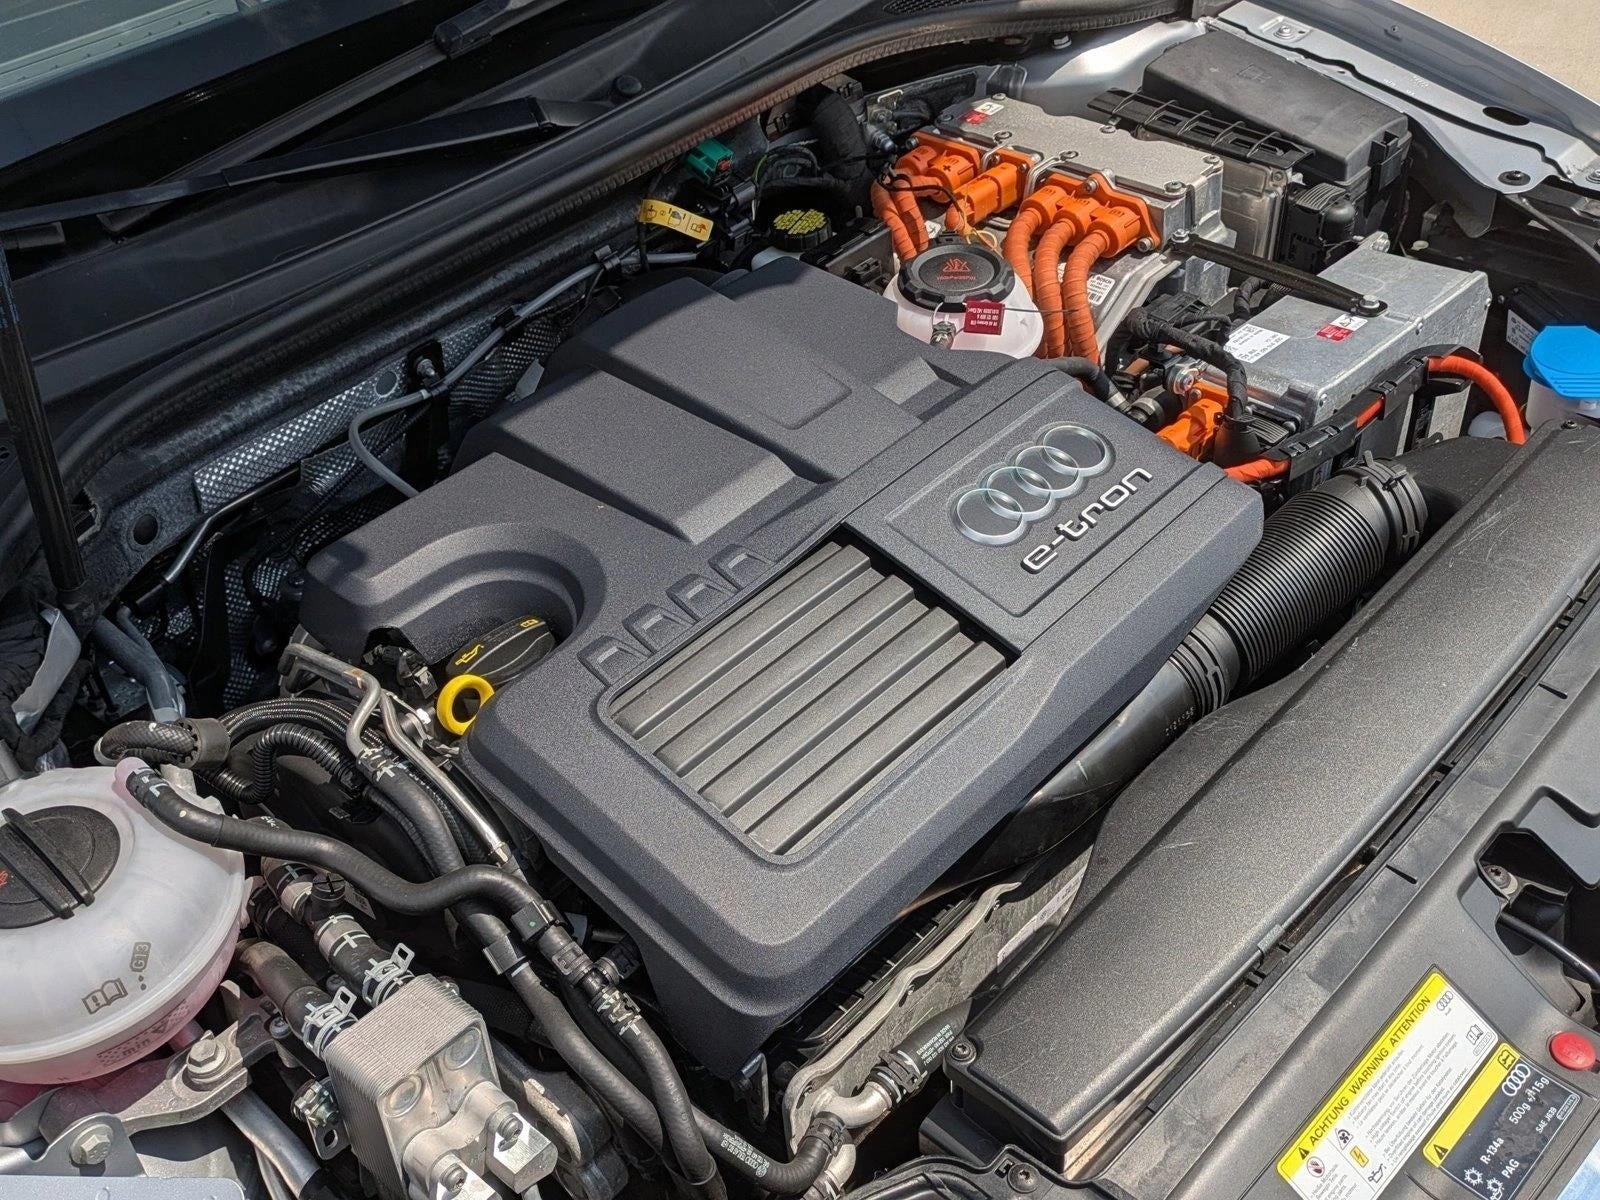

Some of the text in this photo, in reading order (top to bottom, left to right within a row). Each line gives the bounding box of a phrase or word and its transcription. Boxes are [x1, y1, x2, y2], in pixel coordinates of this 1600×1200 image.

[1022, 468, 1152, 573] e-tron
[131, 943, 150, 970] G13
[122, 1038, 150, 1056] min
[1308, 1095, 1350, 1147] ACHTUNG
[1350, 1047, 1389, 1096] WARNING
[1389, 995, 1431, 1048] ATTENTION
[1508, 1099, 1531, 1125] 500g
[1534, 1119, 1548, 1134] SAE
[1479, 1135, 1506, 1165] R-134a
[1500, 1157, 1520, 1179] PAG
